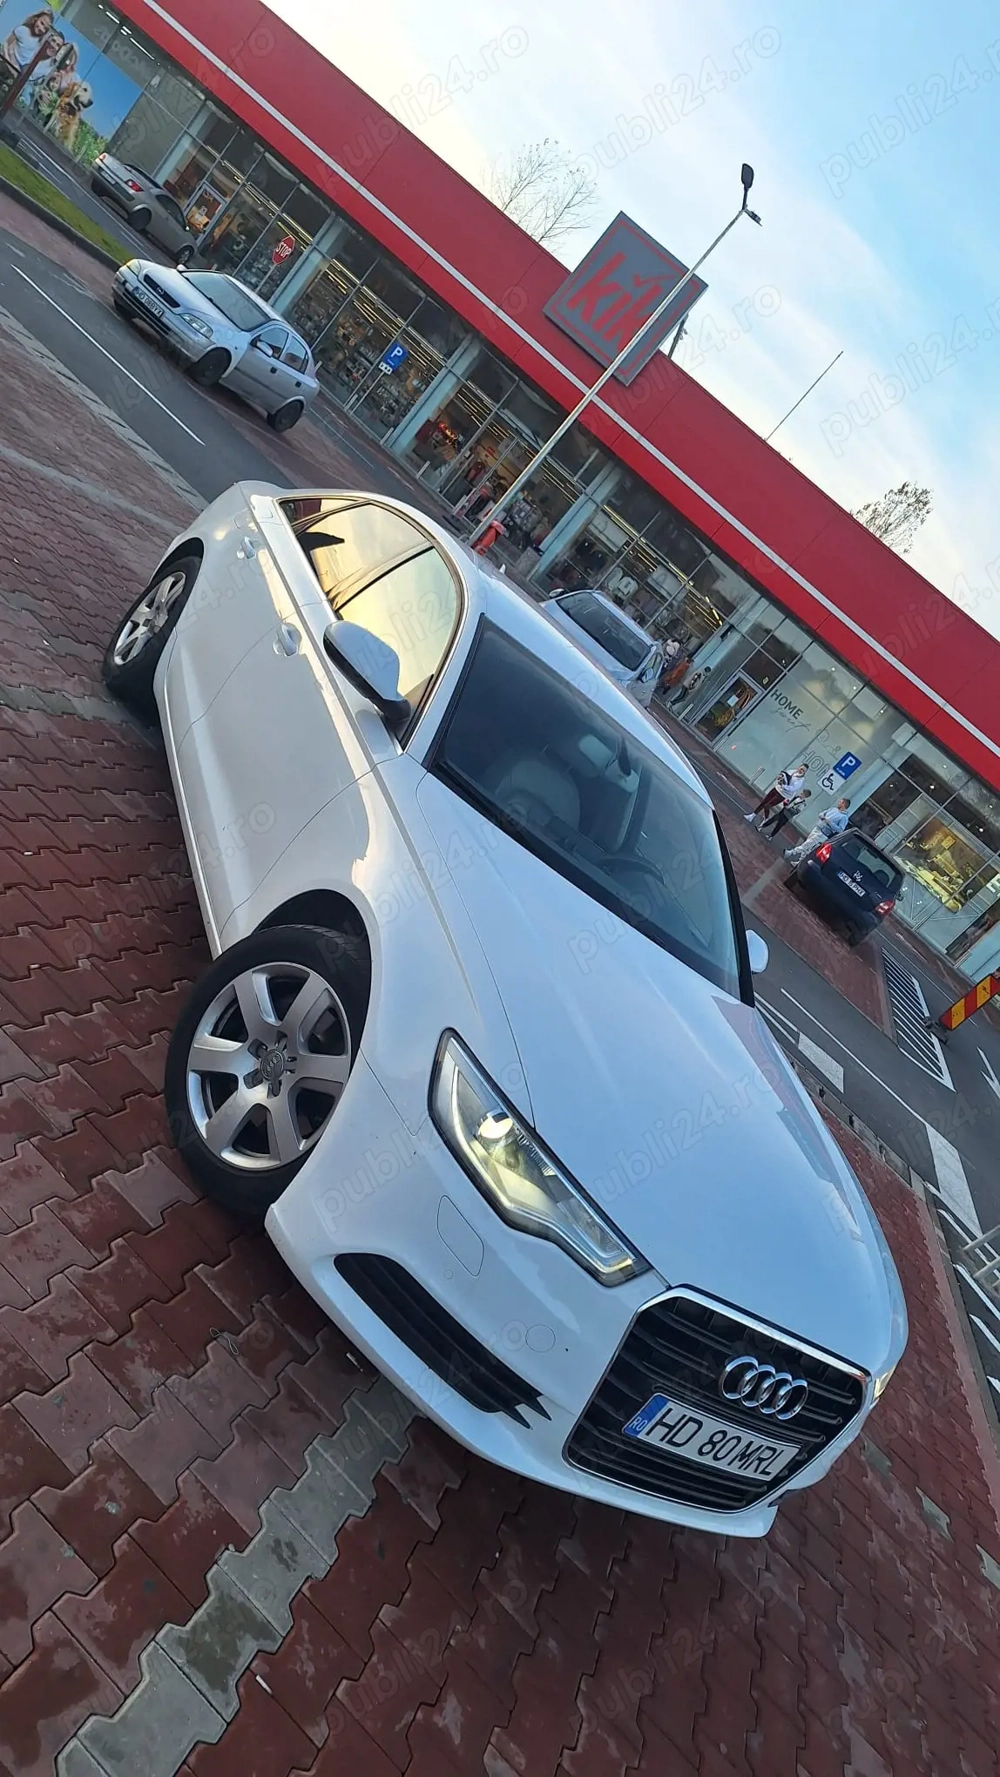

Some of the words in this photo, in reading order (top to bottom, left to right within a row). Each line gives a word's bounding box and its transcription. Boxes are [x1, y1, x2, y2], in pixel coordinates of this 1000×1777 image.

[275, 241, 292, 259] STOP
[390, 346, 403, 358] P
[770, 689, 804, 719] HOME
[841, 756, 856, 768] P
[629, 1417, 648, 1431] RO
[645, 1408, 703, 1448] HD
